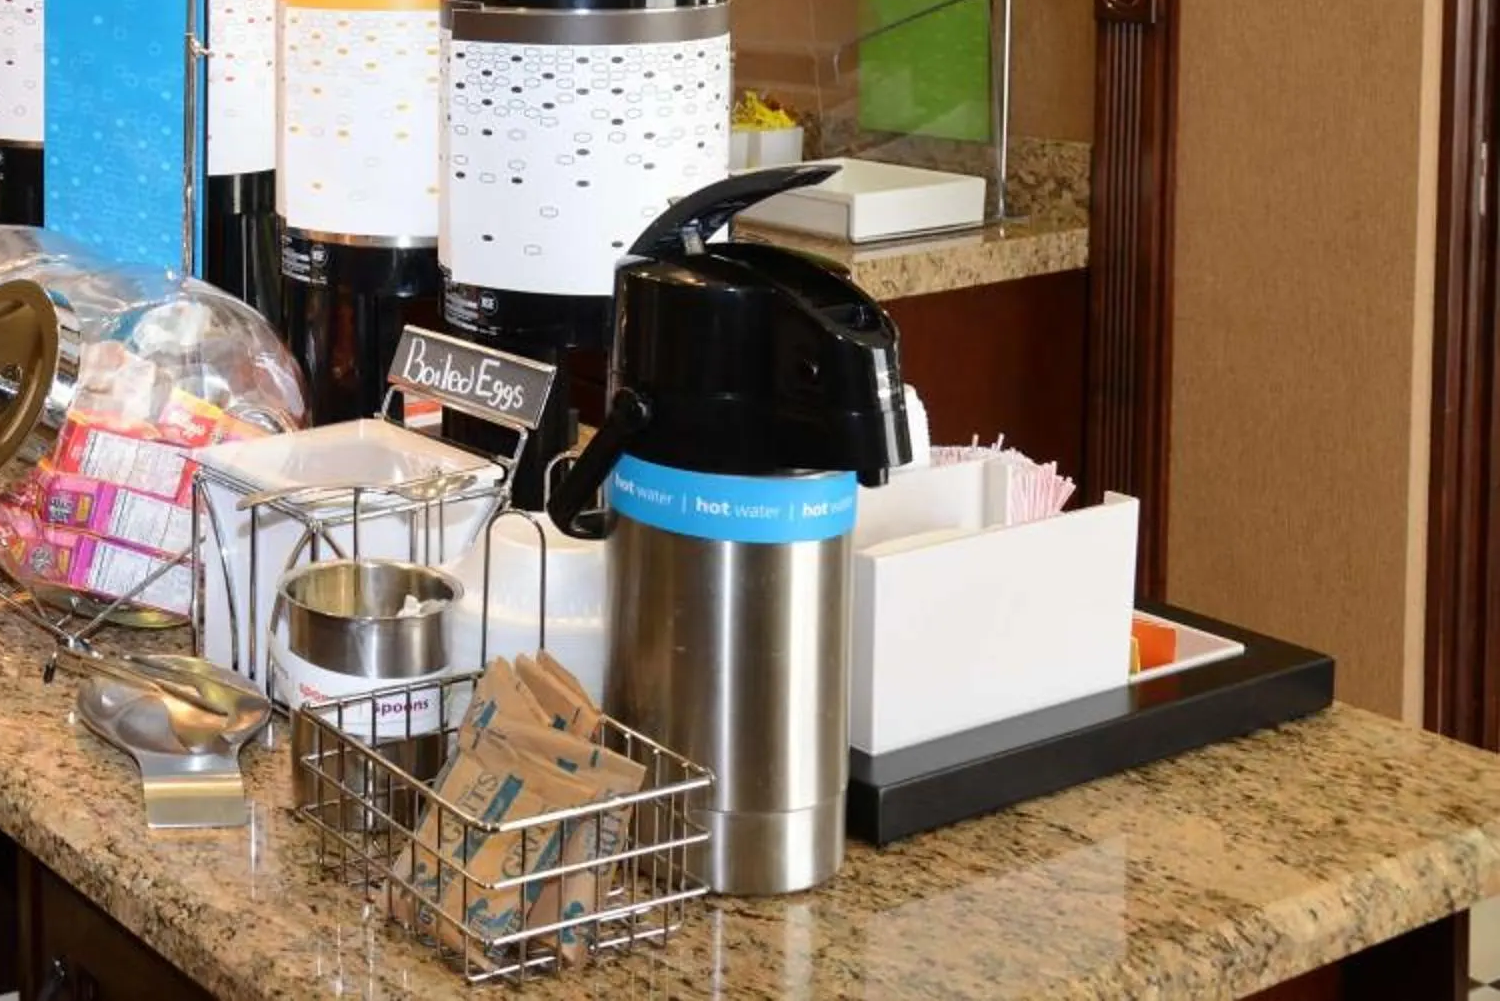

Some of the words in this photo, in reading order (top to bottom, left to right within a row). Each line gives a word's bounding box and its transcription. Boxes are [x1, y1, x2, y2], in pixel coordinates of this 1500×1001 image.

[402, 337, 475, 394] Boiled
[475, 358, 525, 411] Eggs
[615, 472, 635, 495] hot
[636, 486, 673, 504] water
[695, 497, 730, 517] hot
[735, 505, 781, 520] water
[803, 501, 829, 517] hot
